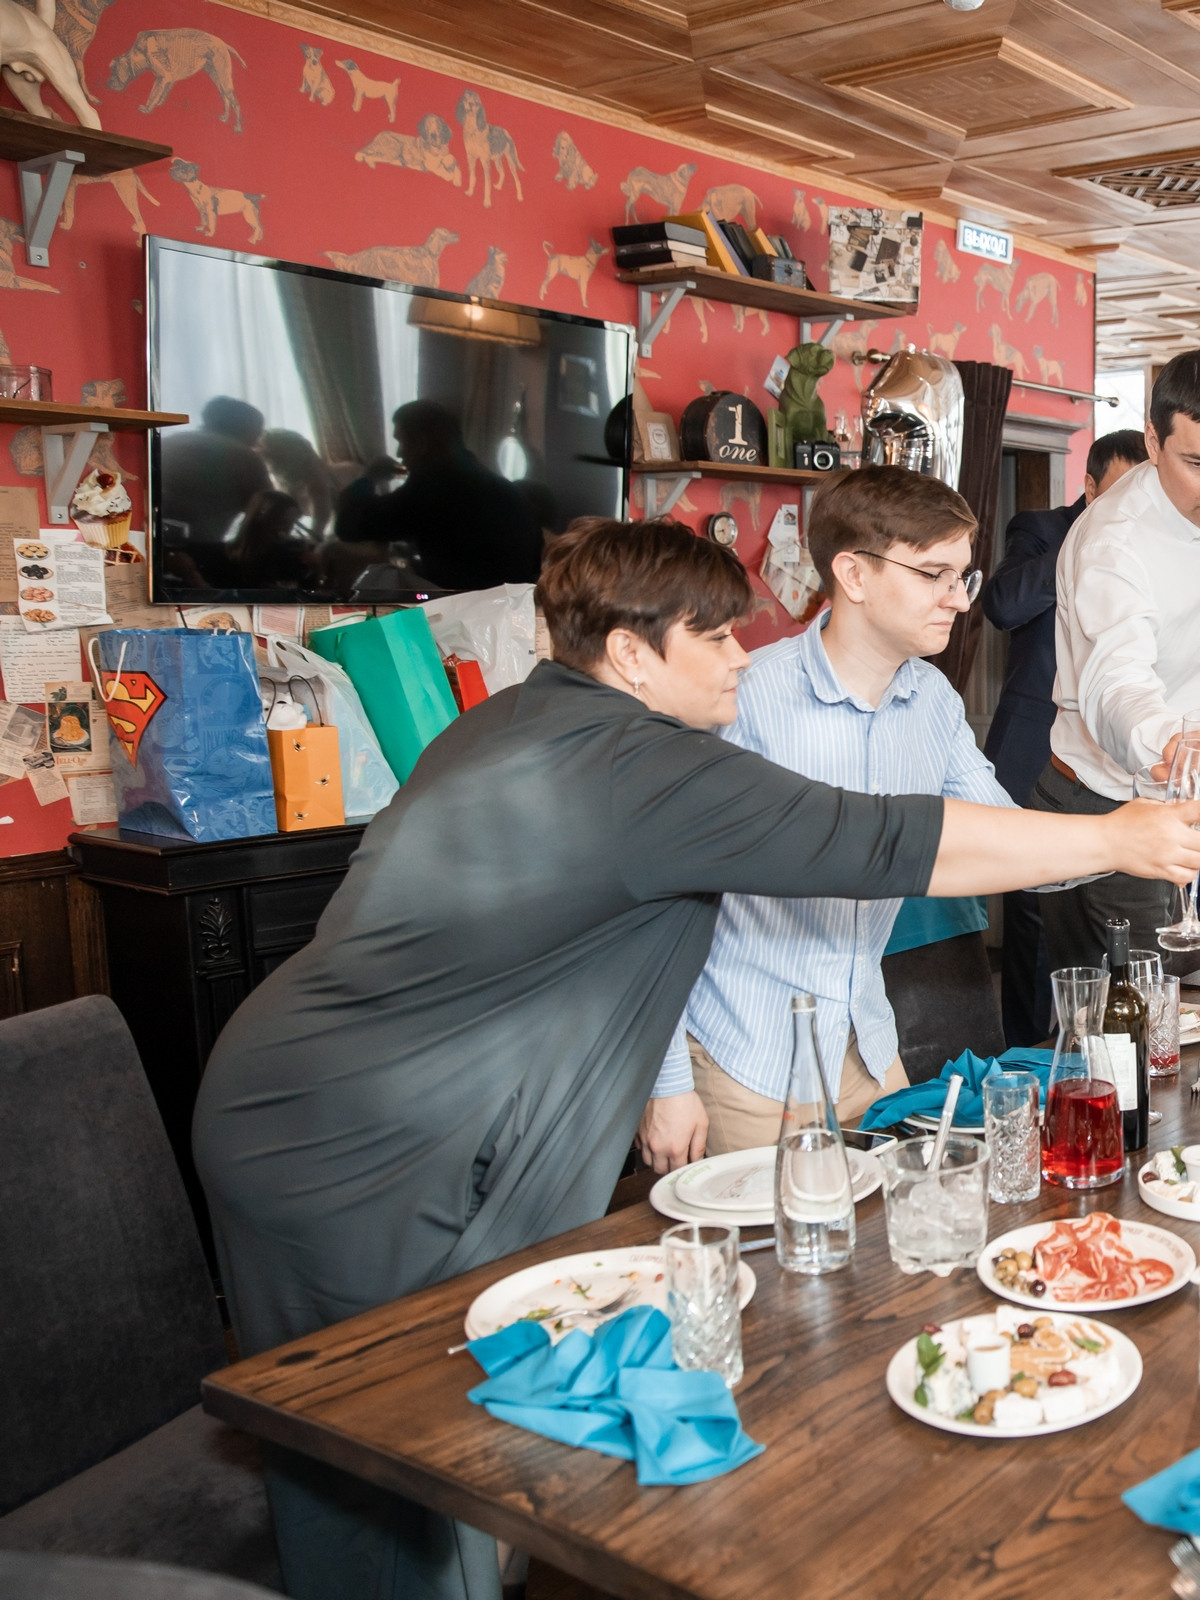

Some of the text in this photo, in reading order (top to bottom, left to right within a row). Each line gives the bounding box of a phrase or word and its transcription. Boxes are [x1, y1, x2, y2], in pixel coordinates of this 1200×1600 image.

[964, 228, 1006, 256] ВЫХОД
[728, 404, 748, 445] 1
[719, 445, 757, 461] one
